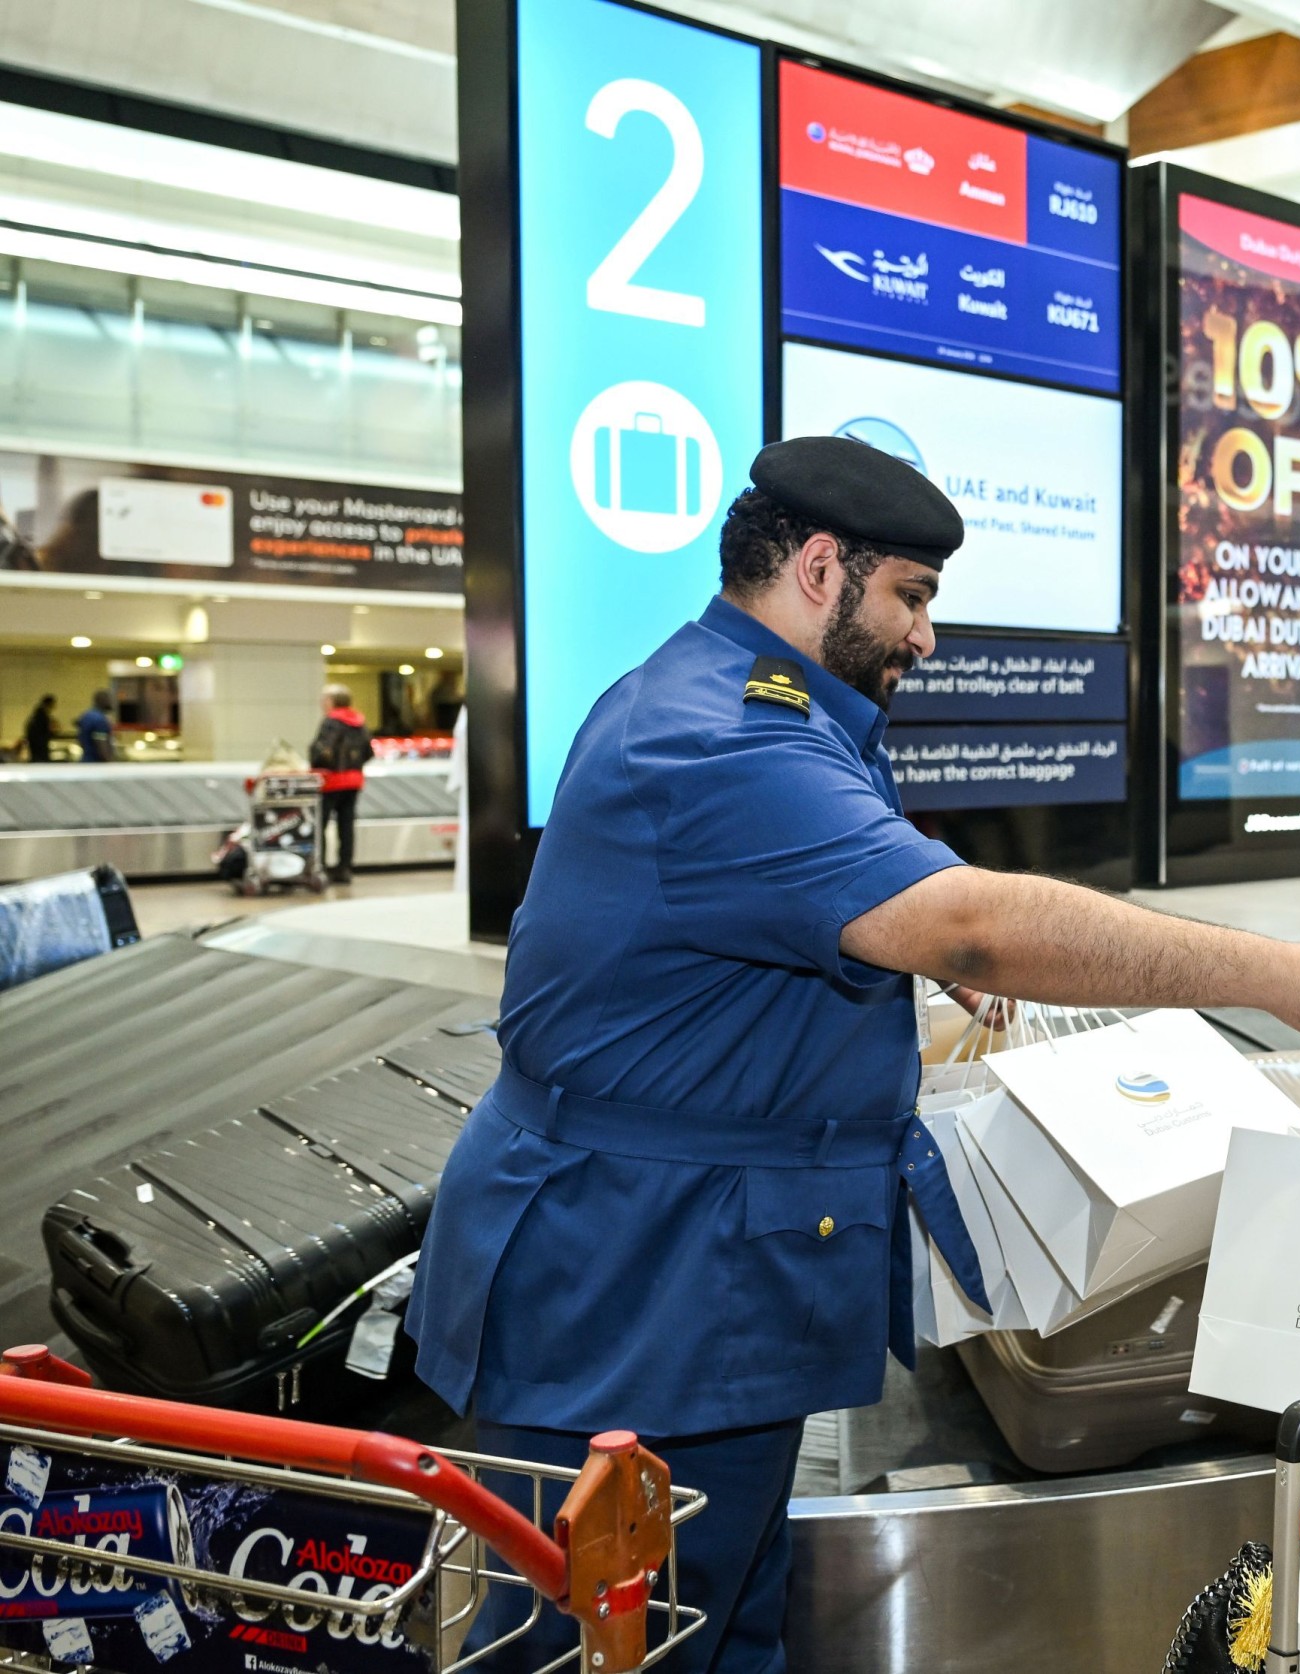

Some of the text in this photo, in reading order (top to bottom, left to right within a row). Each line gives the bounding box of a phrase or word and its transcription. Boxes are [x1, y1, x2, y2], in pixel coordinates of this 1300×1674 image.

[584, 77, 706, 329] 2
[250, 488, 292, 514] Use
[946, 475, 1097, 514] UAE and Kuwait
[431, 544, 464, 568] UA
[1215, 540, 1250, 571] ON
[1201, 616, 1266, 643] DUBAI
[925, 674, 954, 694] and
[955, 674, 1006, 698] trolleys
[1006, 675, 1040, 695] clear
[1040, 675, 1057, 695] of
[1057, 676, 1085, 695] belt
[905, 764, 942, 783] have
[943, 763, 969, 782] the
[969, 764, 1016, 782] correct
[1017, 761, 1076, 783] baggage
[37, 1507, 144, 1540] Alokozay
[228, 1526, 405, 1649] Cola
